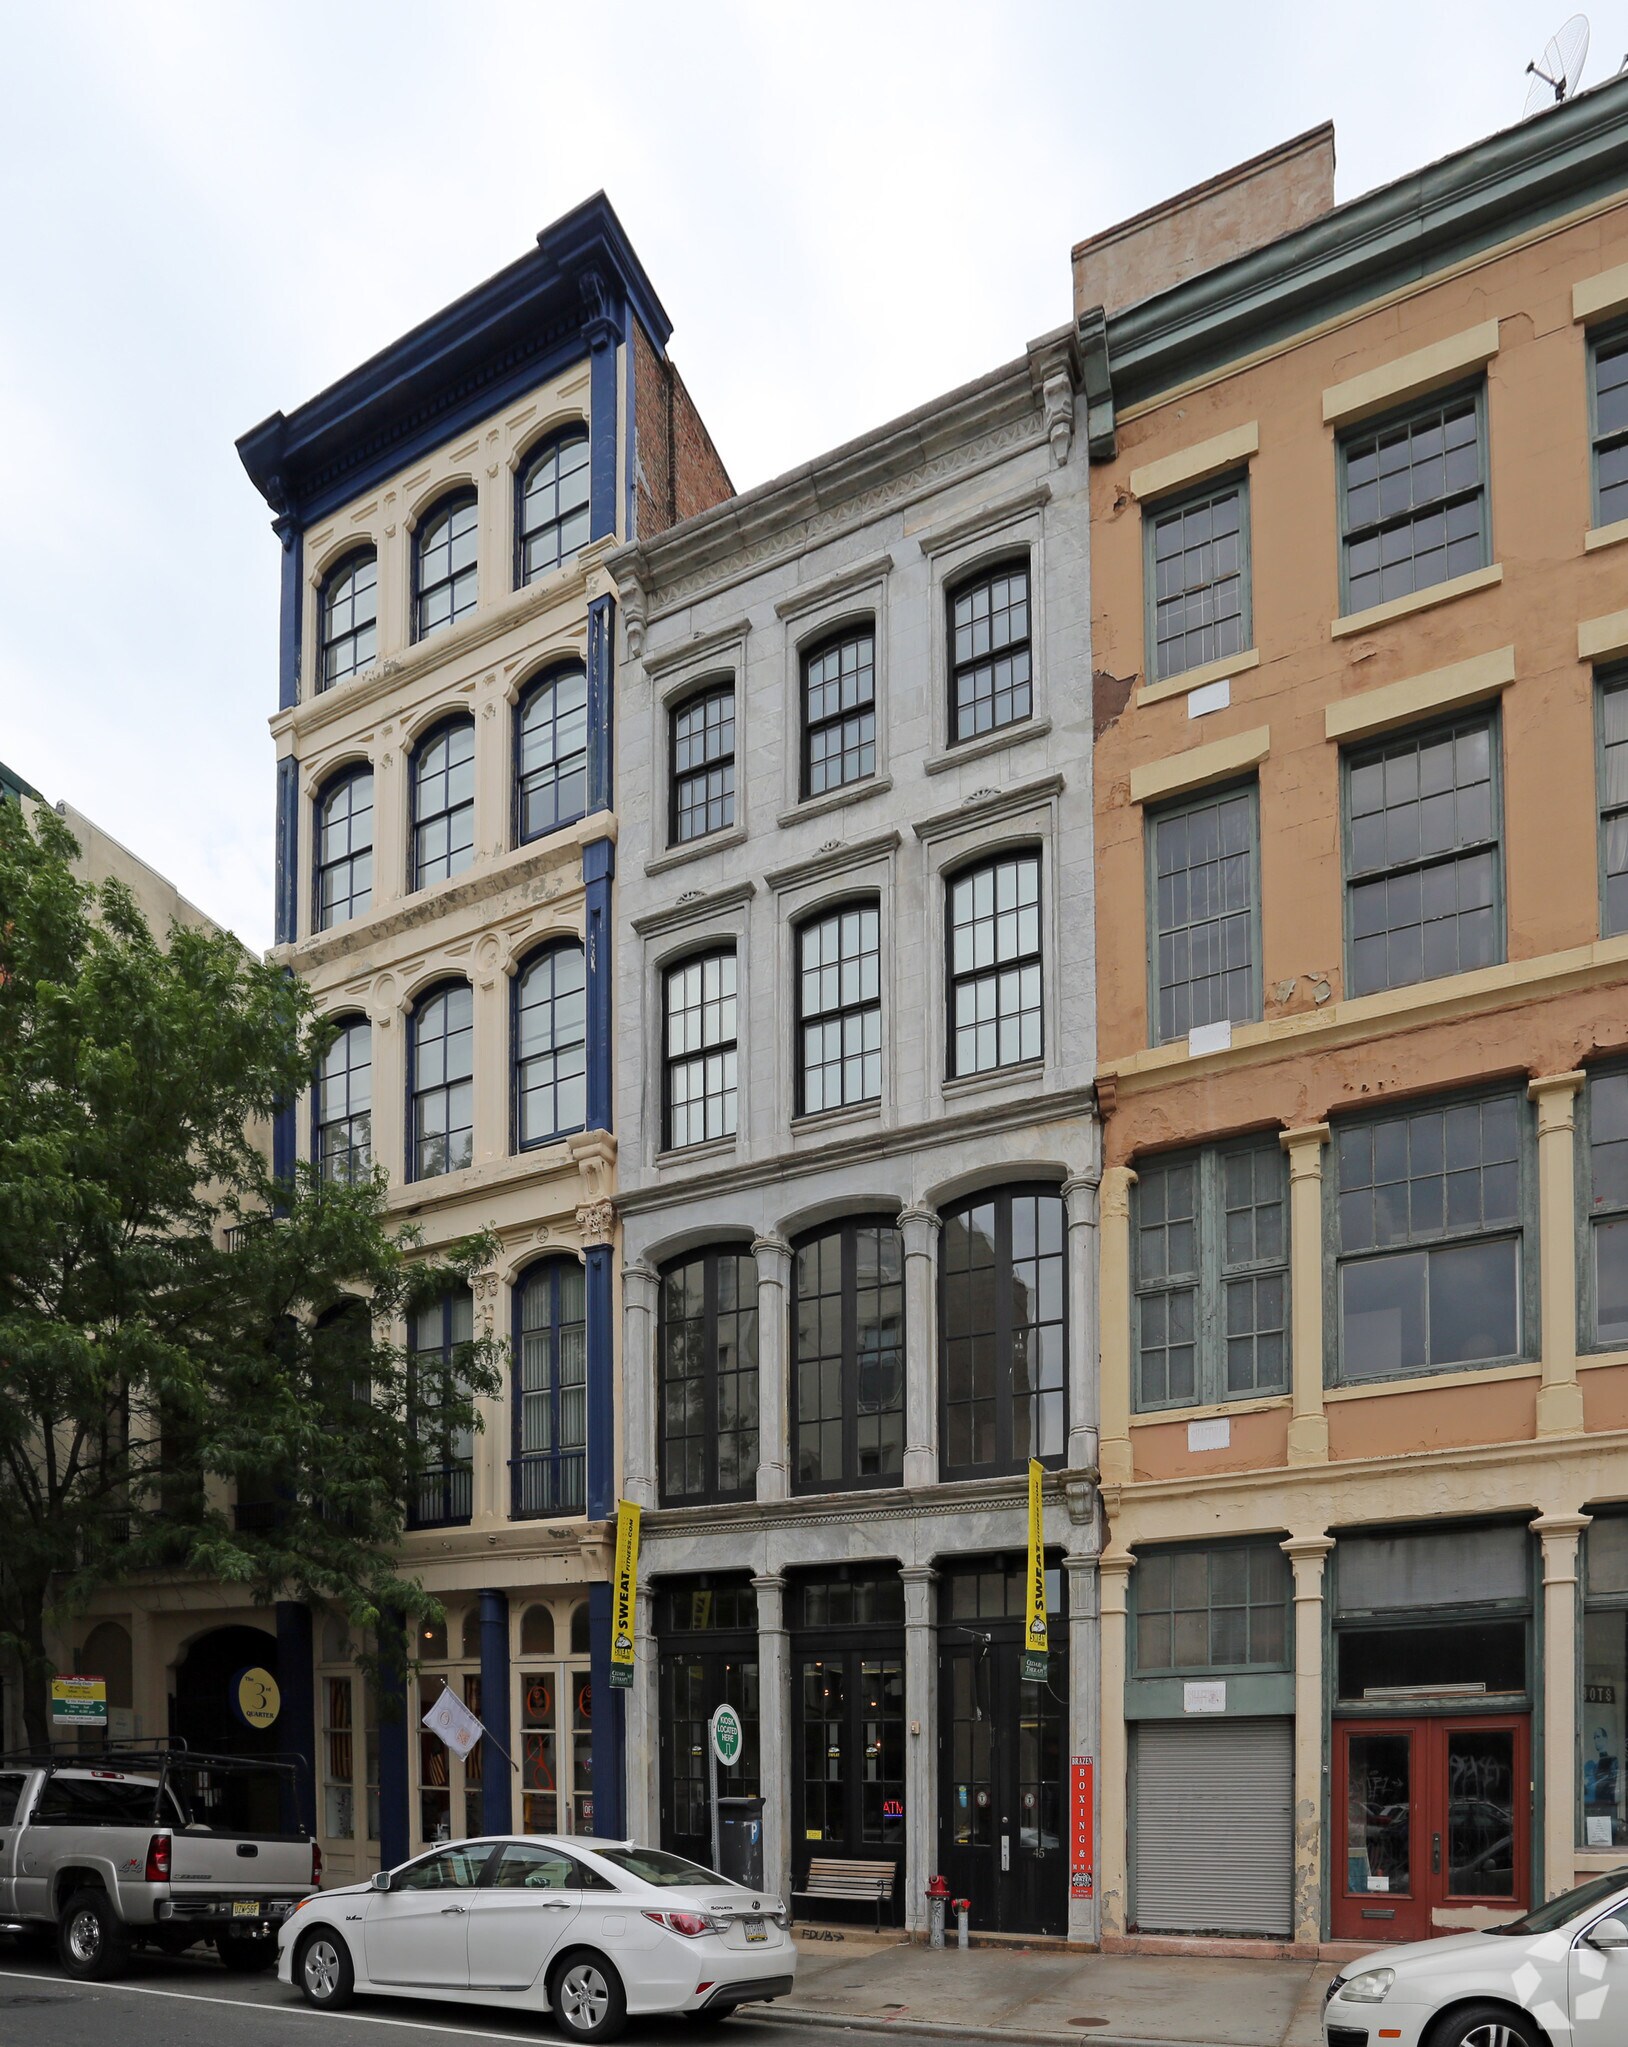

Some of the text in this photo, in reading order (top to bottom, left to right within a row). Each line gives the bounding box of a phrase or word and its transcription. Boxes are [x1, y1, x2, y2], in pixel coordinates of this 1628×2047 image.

[618, 1518, 634, 1630] SWEAT FITNESS.COM
[1035, 1542, 1044, 1611] SWEAT
[720, 1716, 735, 1725] KIOSK
[717, 1725, 738, 1735] LOCATED
[721, 1733, 734, 1742] HERE
[1071, 1757, 1093, 1765] BRAZEN
[883, 1801, 903, 1814] ATM
[1078, 1768, 1086, 1844] BOXING
[751, 1824, 758, 1840] P
[1032, 1848, 1045, 1859] 45
